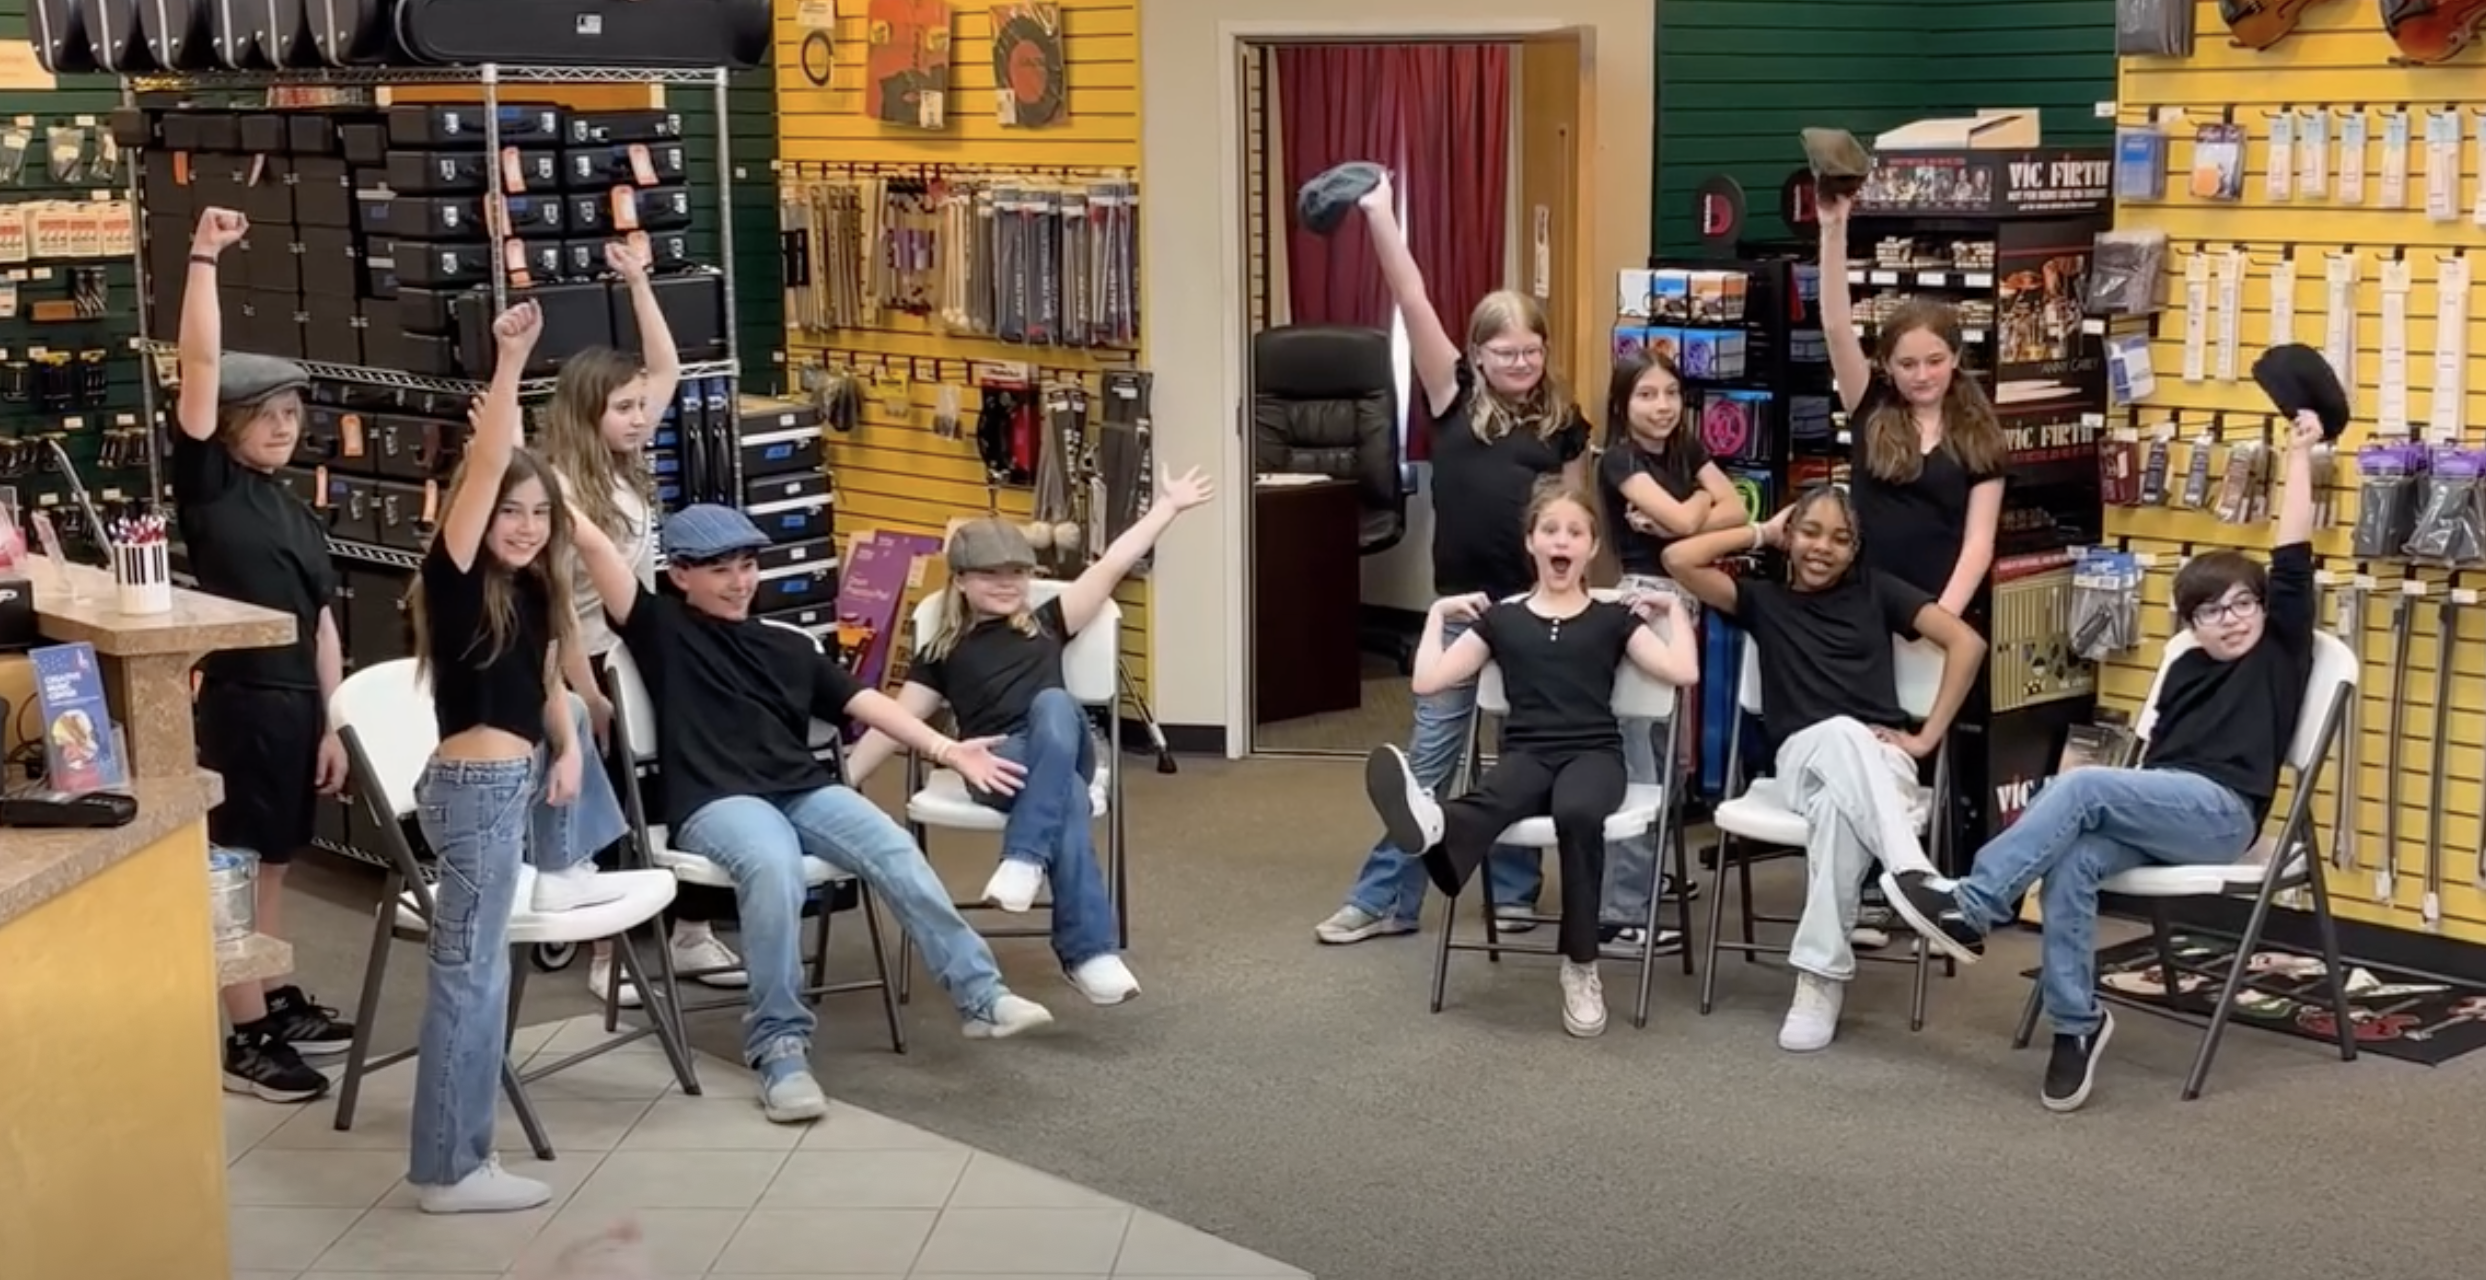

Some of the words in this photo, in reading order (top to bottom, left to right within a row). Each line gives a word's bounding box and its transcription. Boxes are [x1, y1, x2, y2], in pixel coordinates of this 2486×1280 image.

[2008, 155, 2043, 189] VIC
[2050, 154, 2111, 187] FIRTH
[2004, 420, 2033, 451] VIC
[2041, 417, 2093, 448] FIRTH
[1996, 775, 2034, 813] VIC
